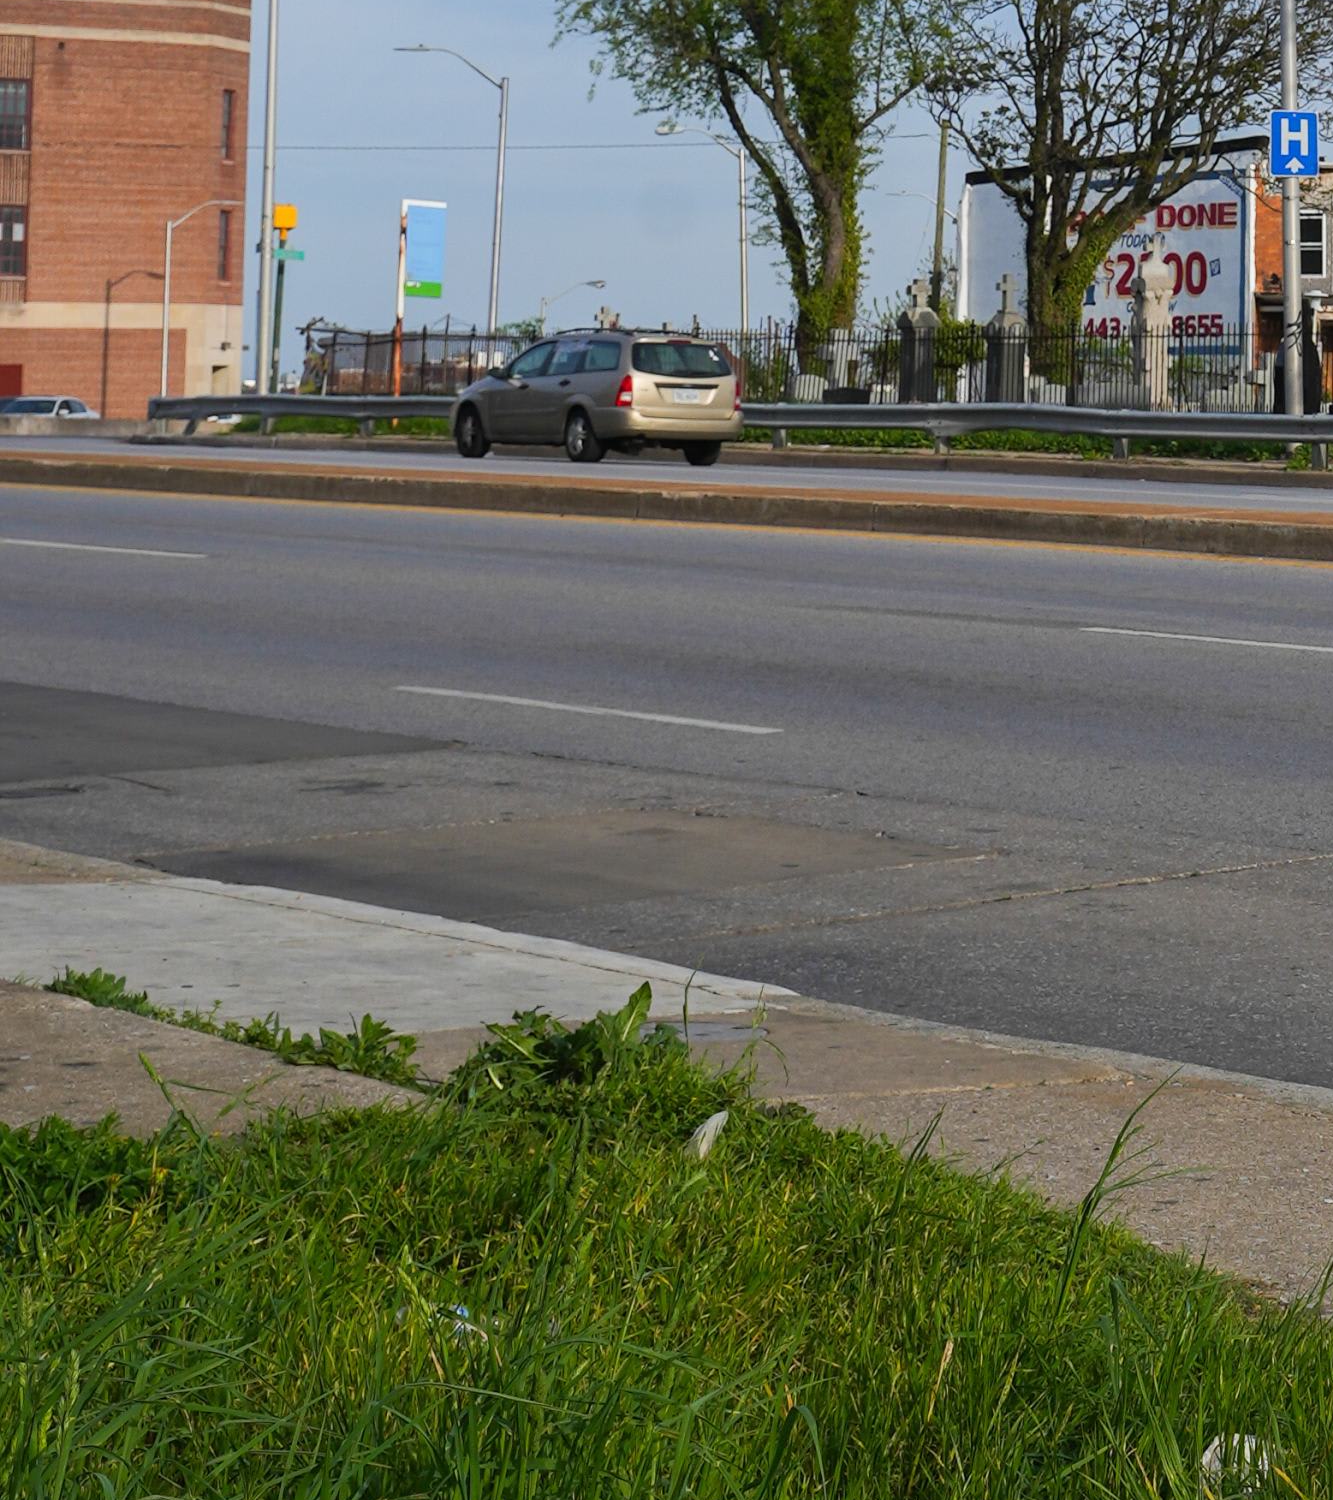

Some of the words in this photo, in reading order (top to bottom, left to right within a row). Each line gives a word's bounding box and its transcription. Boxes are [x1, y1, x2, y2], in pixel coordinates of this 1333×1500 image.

[1281, 118, 1309, 156] H
[1156, 202, 1237, 230] DONE
[1103, 251, 1208, 297] $200
